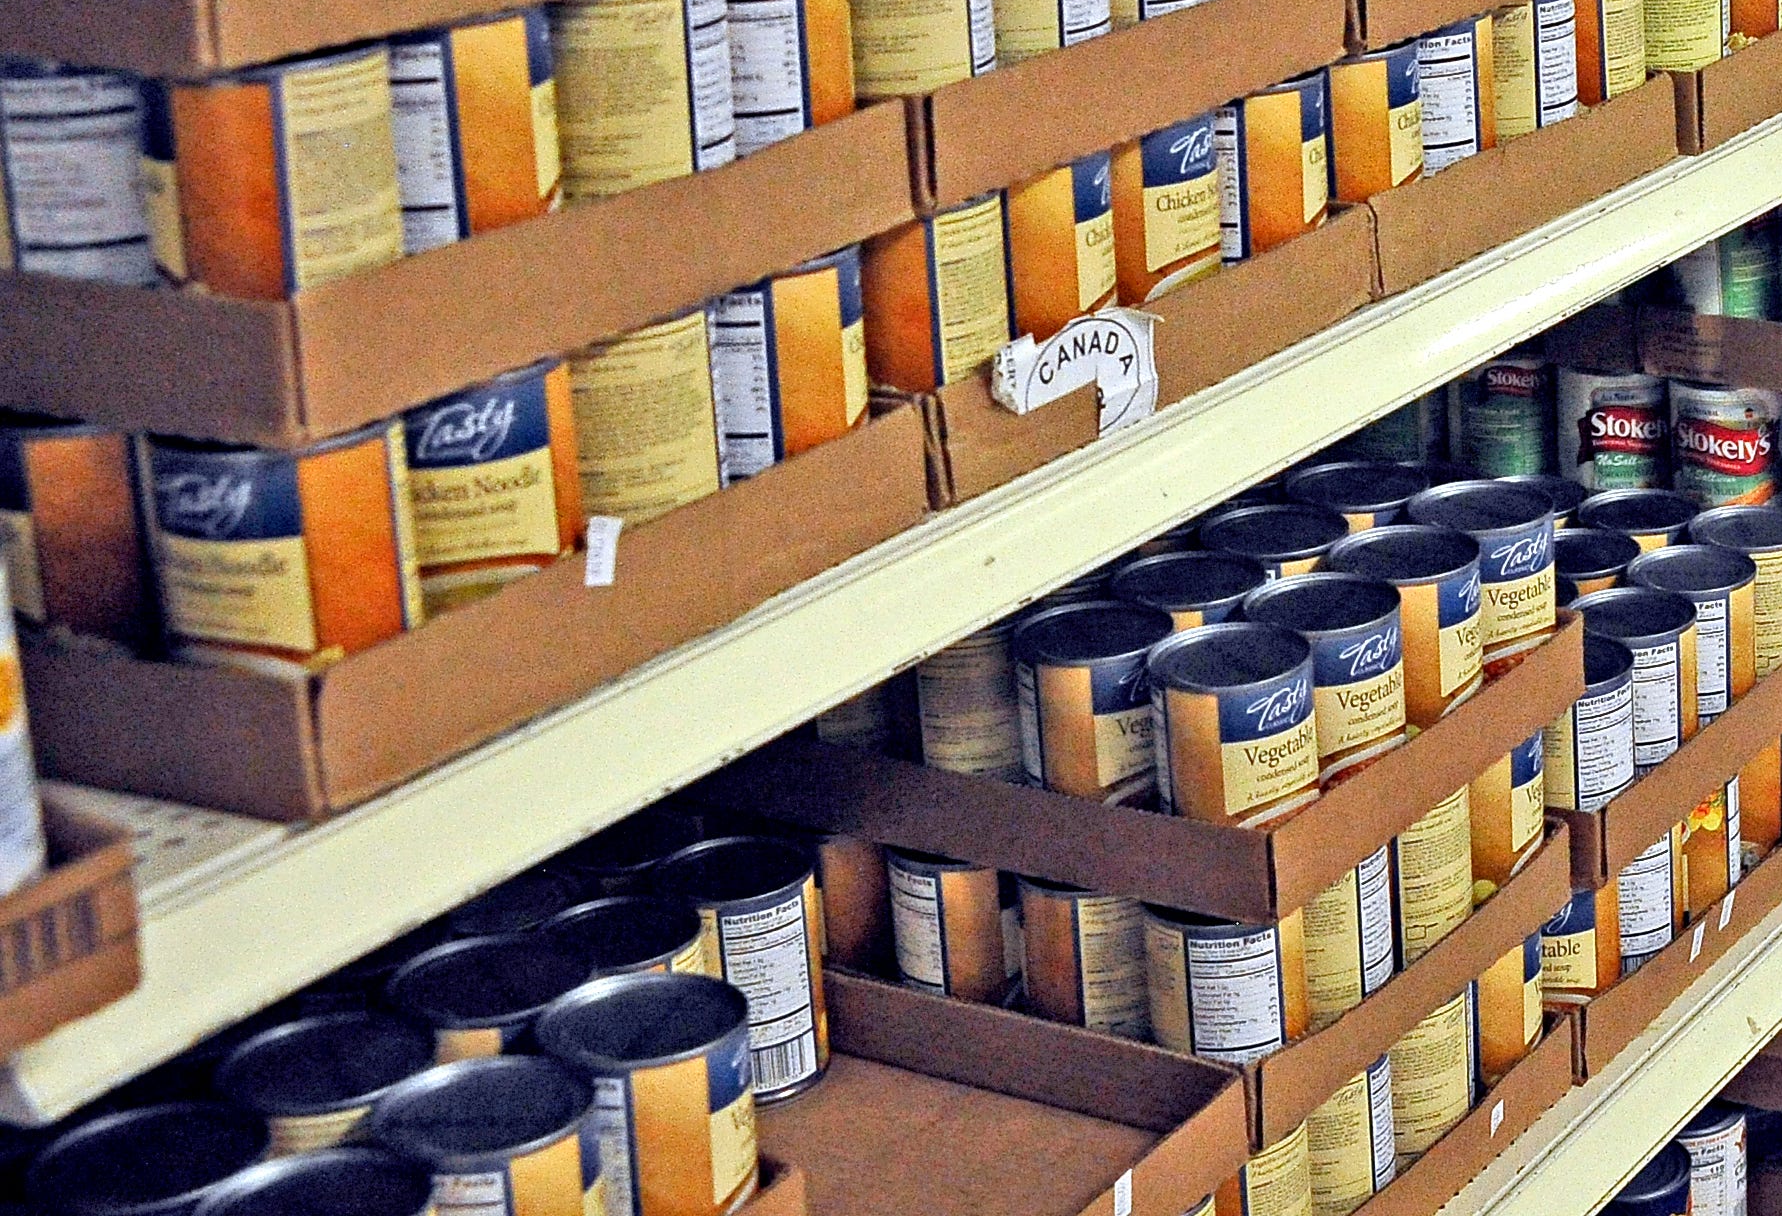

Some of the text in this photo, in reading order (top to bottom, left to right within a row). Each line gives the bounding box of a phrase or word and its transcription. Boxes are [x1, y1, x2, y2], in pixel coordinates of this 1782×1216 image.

[1445, 36, 1471, 47] Facts
[1039, 331, 1133, 384] CANADA
[1491, 533, 1549, 576] Tasty
[1699, 600, 1724, 611] Facts
[1339, 627, 1398, 676] Tasty
[1652, 645, 1675, 656] Facts
[1246, 678, 1307, 731] Tasty
[1577, 694, 1616, 708] Nutrition
[721, 908, 774, 929] Nutrition
[1190, 932, 1271, 949] Nutrition Facts
[1542, 940, 1581, 958] table
